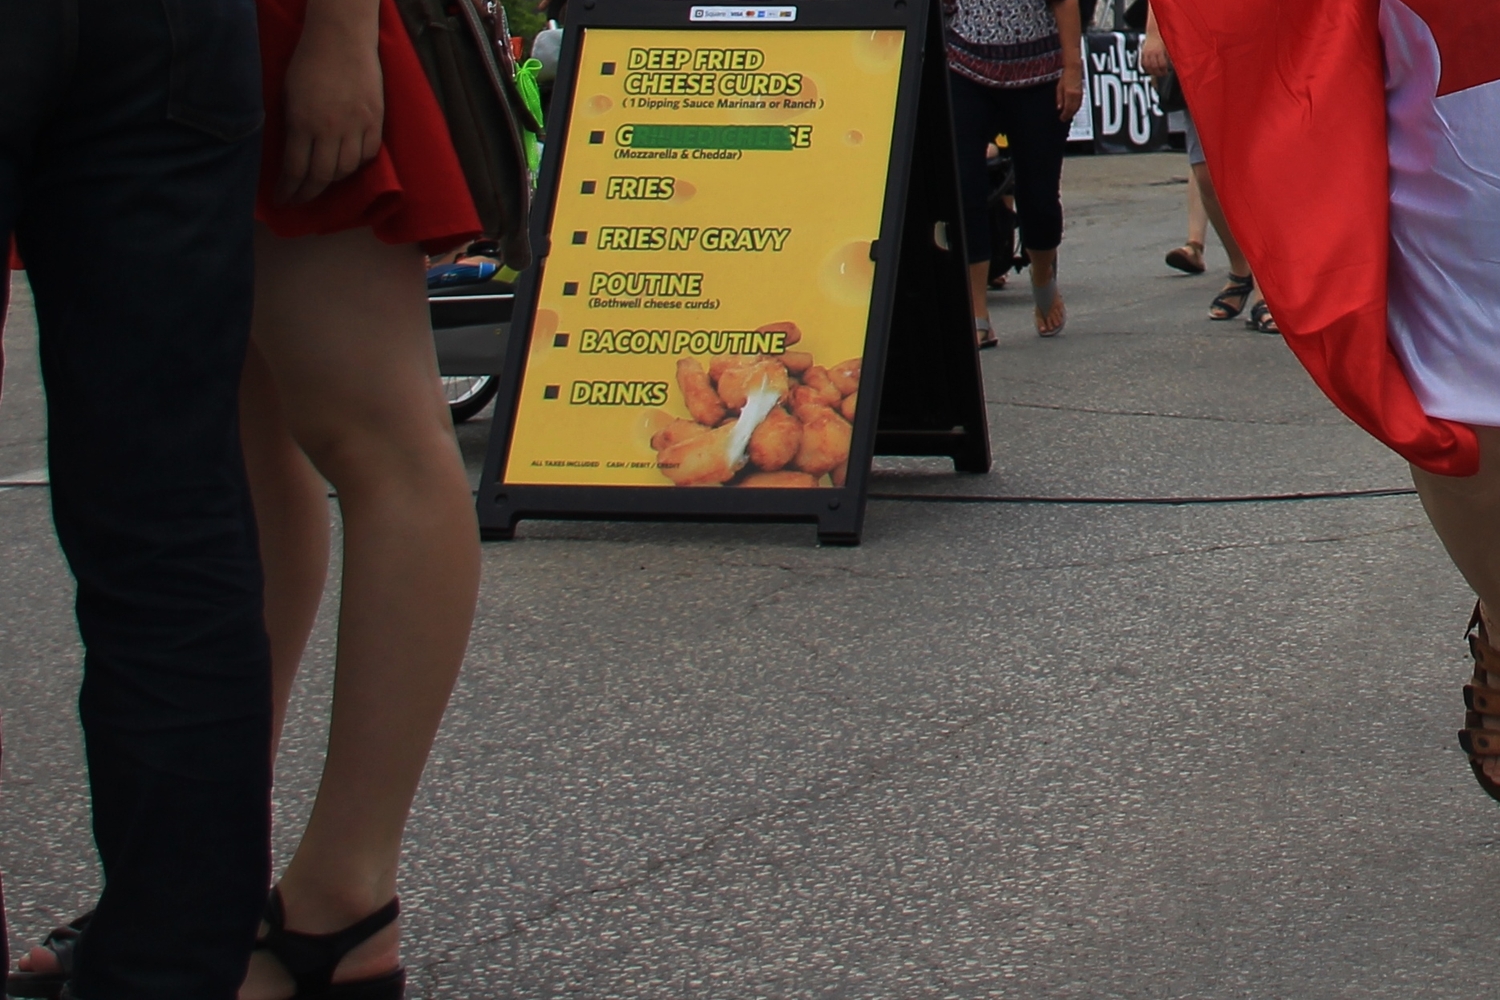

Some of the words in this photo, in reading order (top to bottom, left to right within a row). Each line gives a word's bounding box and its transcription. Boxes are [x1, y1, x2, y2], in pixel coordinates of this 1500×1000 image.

[627, 48, 692, 71] DEEP
[693, 48, 765, 72] FRIED
[624, 72, 716, 96] CHEESE
[718, 73, 802, 97] CURDS
[638, 98, 680, 110] Dipping
[682, 98, 715, 108] Sauce
[717, 98, 766, 109] Marinara
[769, 101, 781, 109] or
[614, 149, 678, 160] (Mozzarella
[680, 150, 689, 159] &
[691, 150, 742, 161] Cheddar)
[606, 176, 675, 200] FRIES
[597, 226, 667, 250] FRIES
[700, 227, 791, 252] GRAVY
[589, 272, 703, 297] POUTINE
[588, 298, 642, 309] (Bothwell
[643, 299, 682, 309] cheese
[684, 299, 720, 310] curds)
[580, 329, 670, 353] BACON
[672, 330, 787, 355] POUTINE
[570, 381, 668, 406] DRINKS
